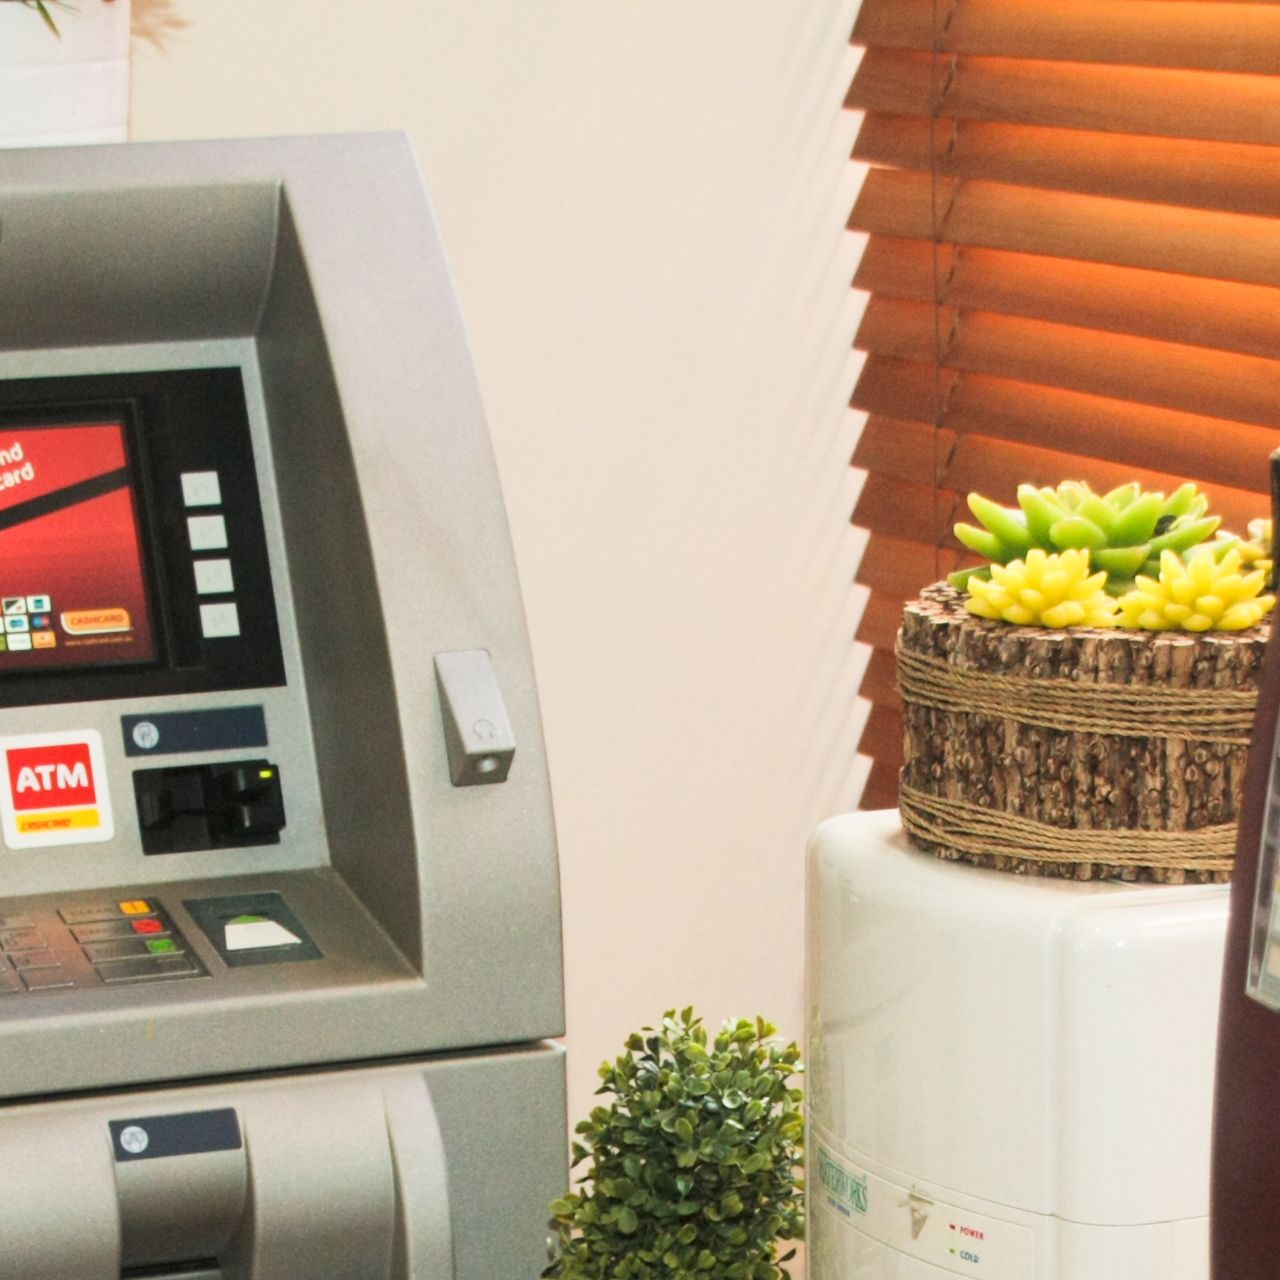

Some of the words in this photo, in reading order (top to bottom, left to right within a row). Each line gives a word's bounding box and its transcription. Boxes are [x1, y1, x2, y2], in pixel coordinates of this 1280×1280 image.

[70, 614, 125, 626] CASHCARD
[16, 761, 90, 793] ATM
[960, 1225, 985, 1241] POWER
[959, 1250, 980, 1264] COLD
